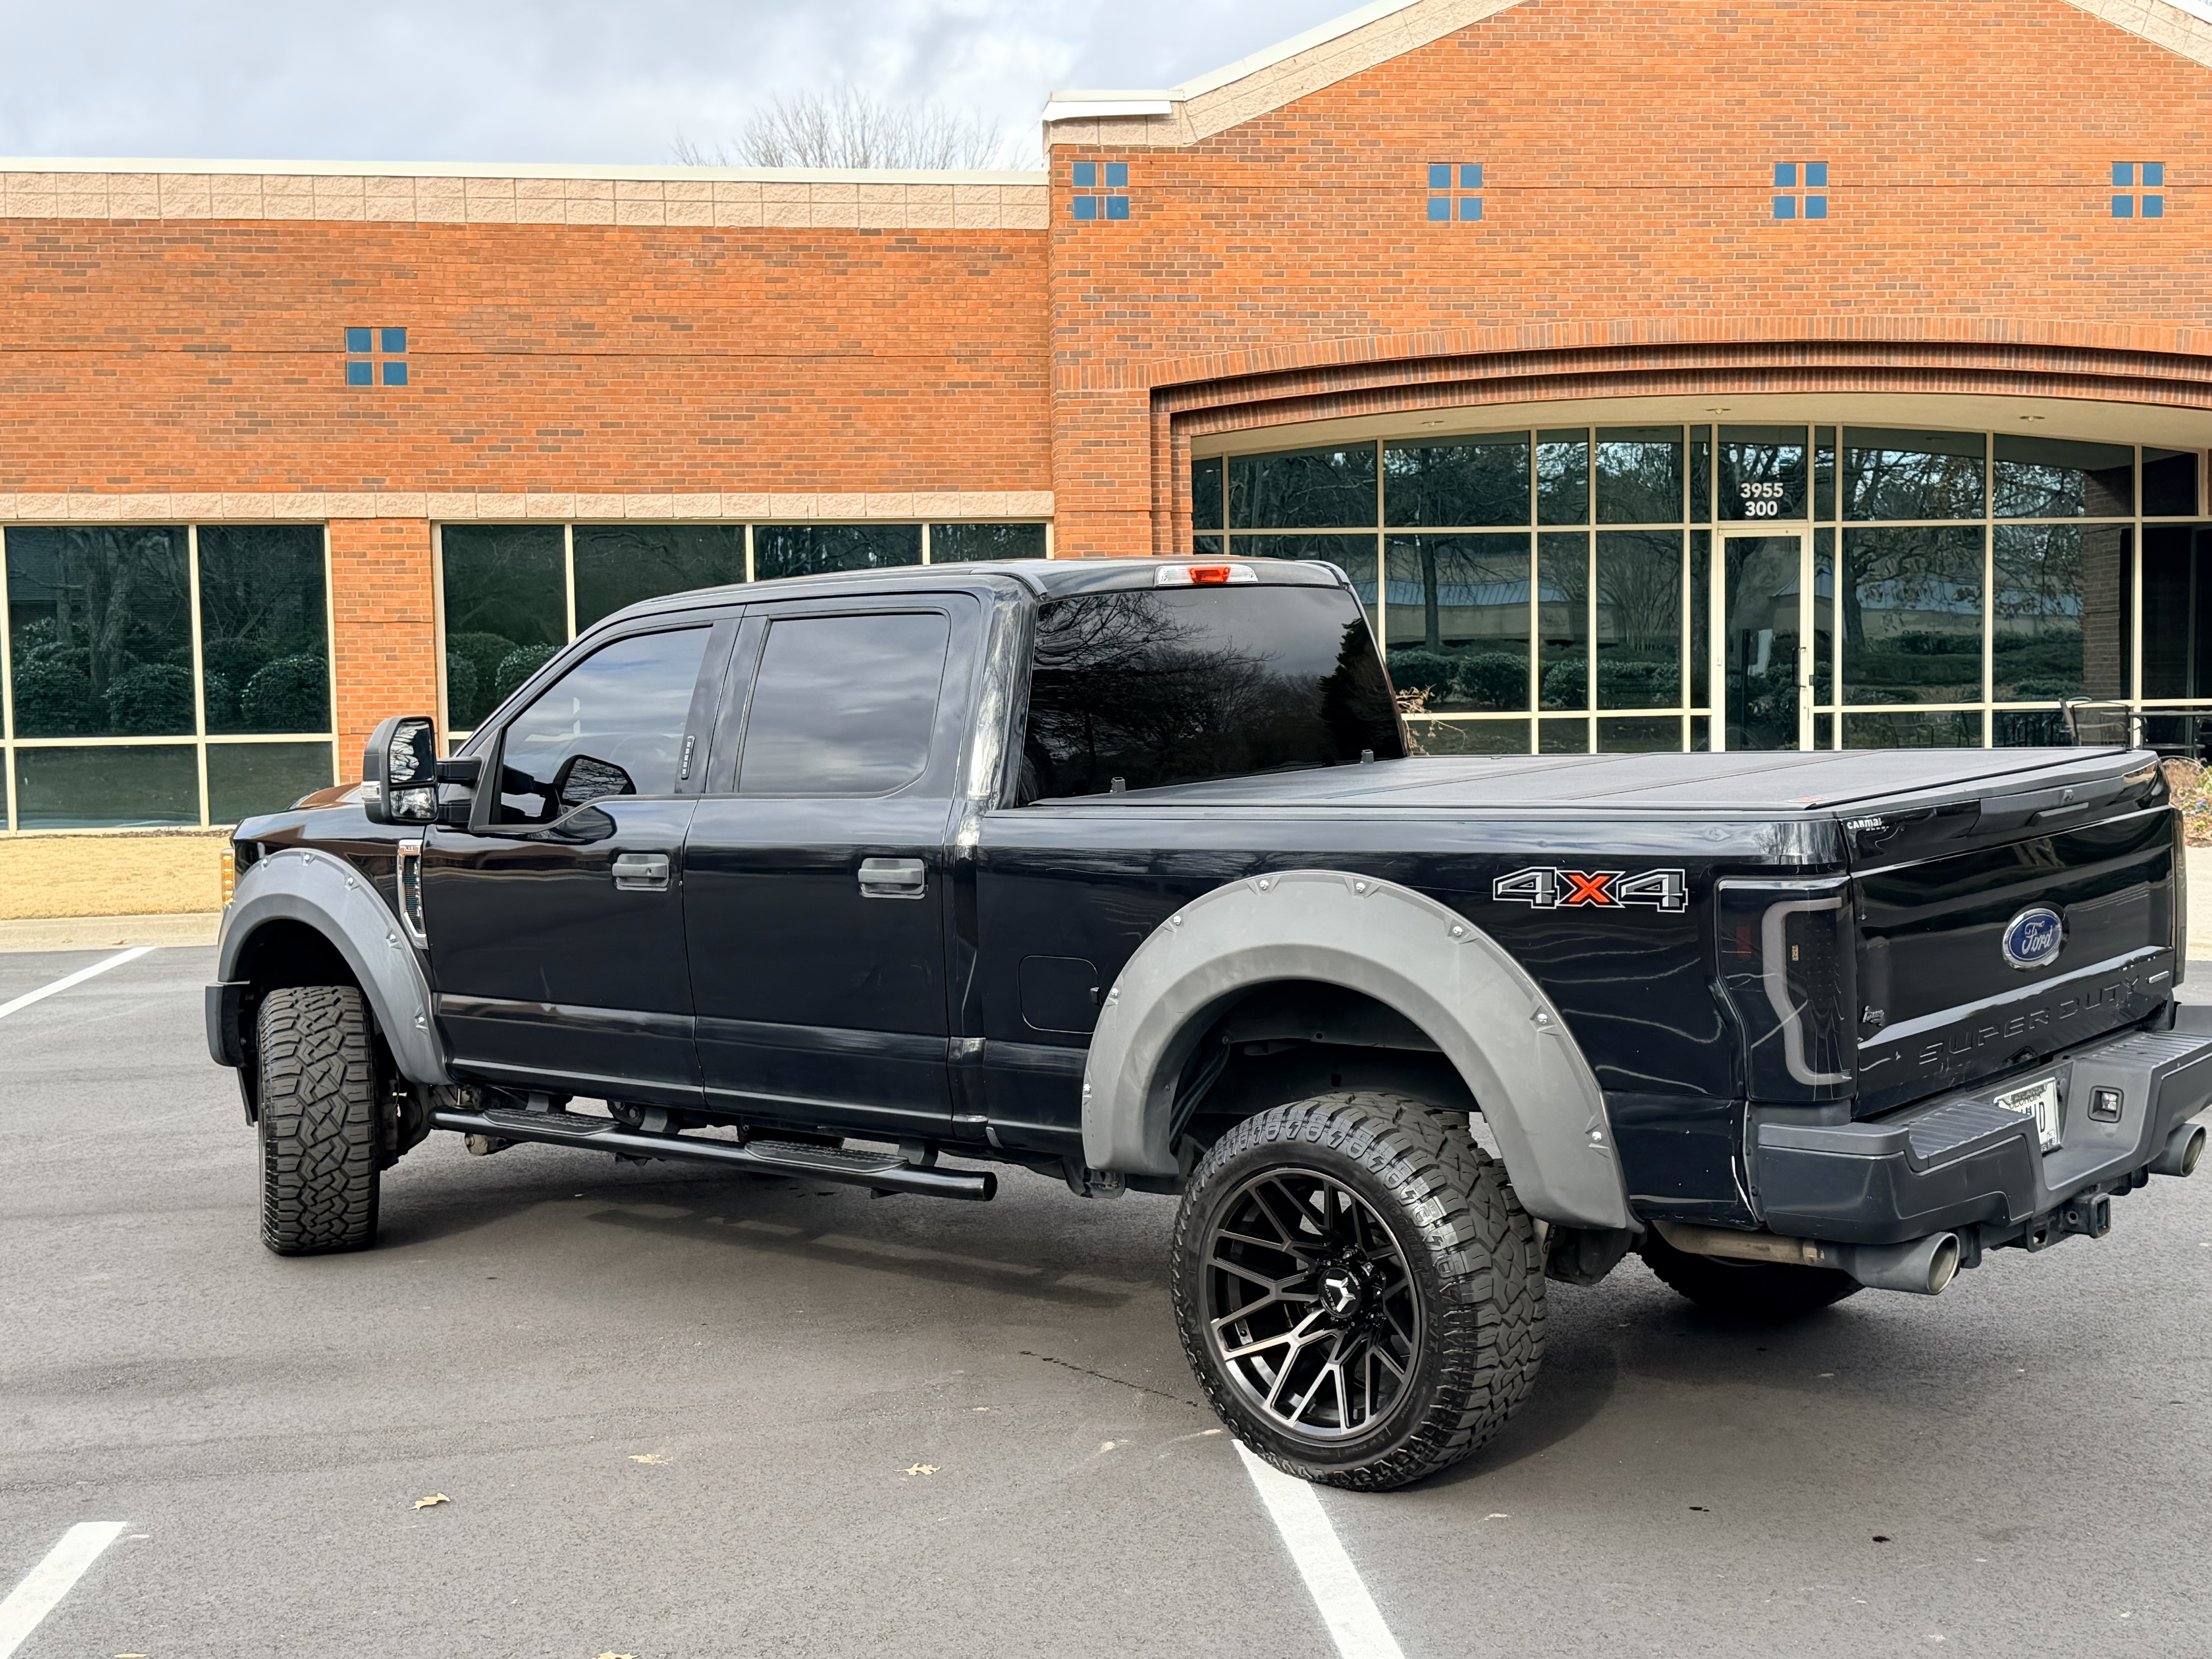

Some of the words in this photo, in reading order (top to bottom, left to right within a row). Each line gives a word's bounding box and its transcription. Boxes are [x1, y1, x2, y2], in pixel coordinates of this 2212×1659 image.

[1740, 483, 1784, 498] 3955
[1745, 501, 1778, 516] 300
[2021, 920, 2053, 955] Ford
[1919, 1006, 2051, 1065] SUPER
[2059, 975, 2140, 1020] DUTY
